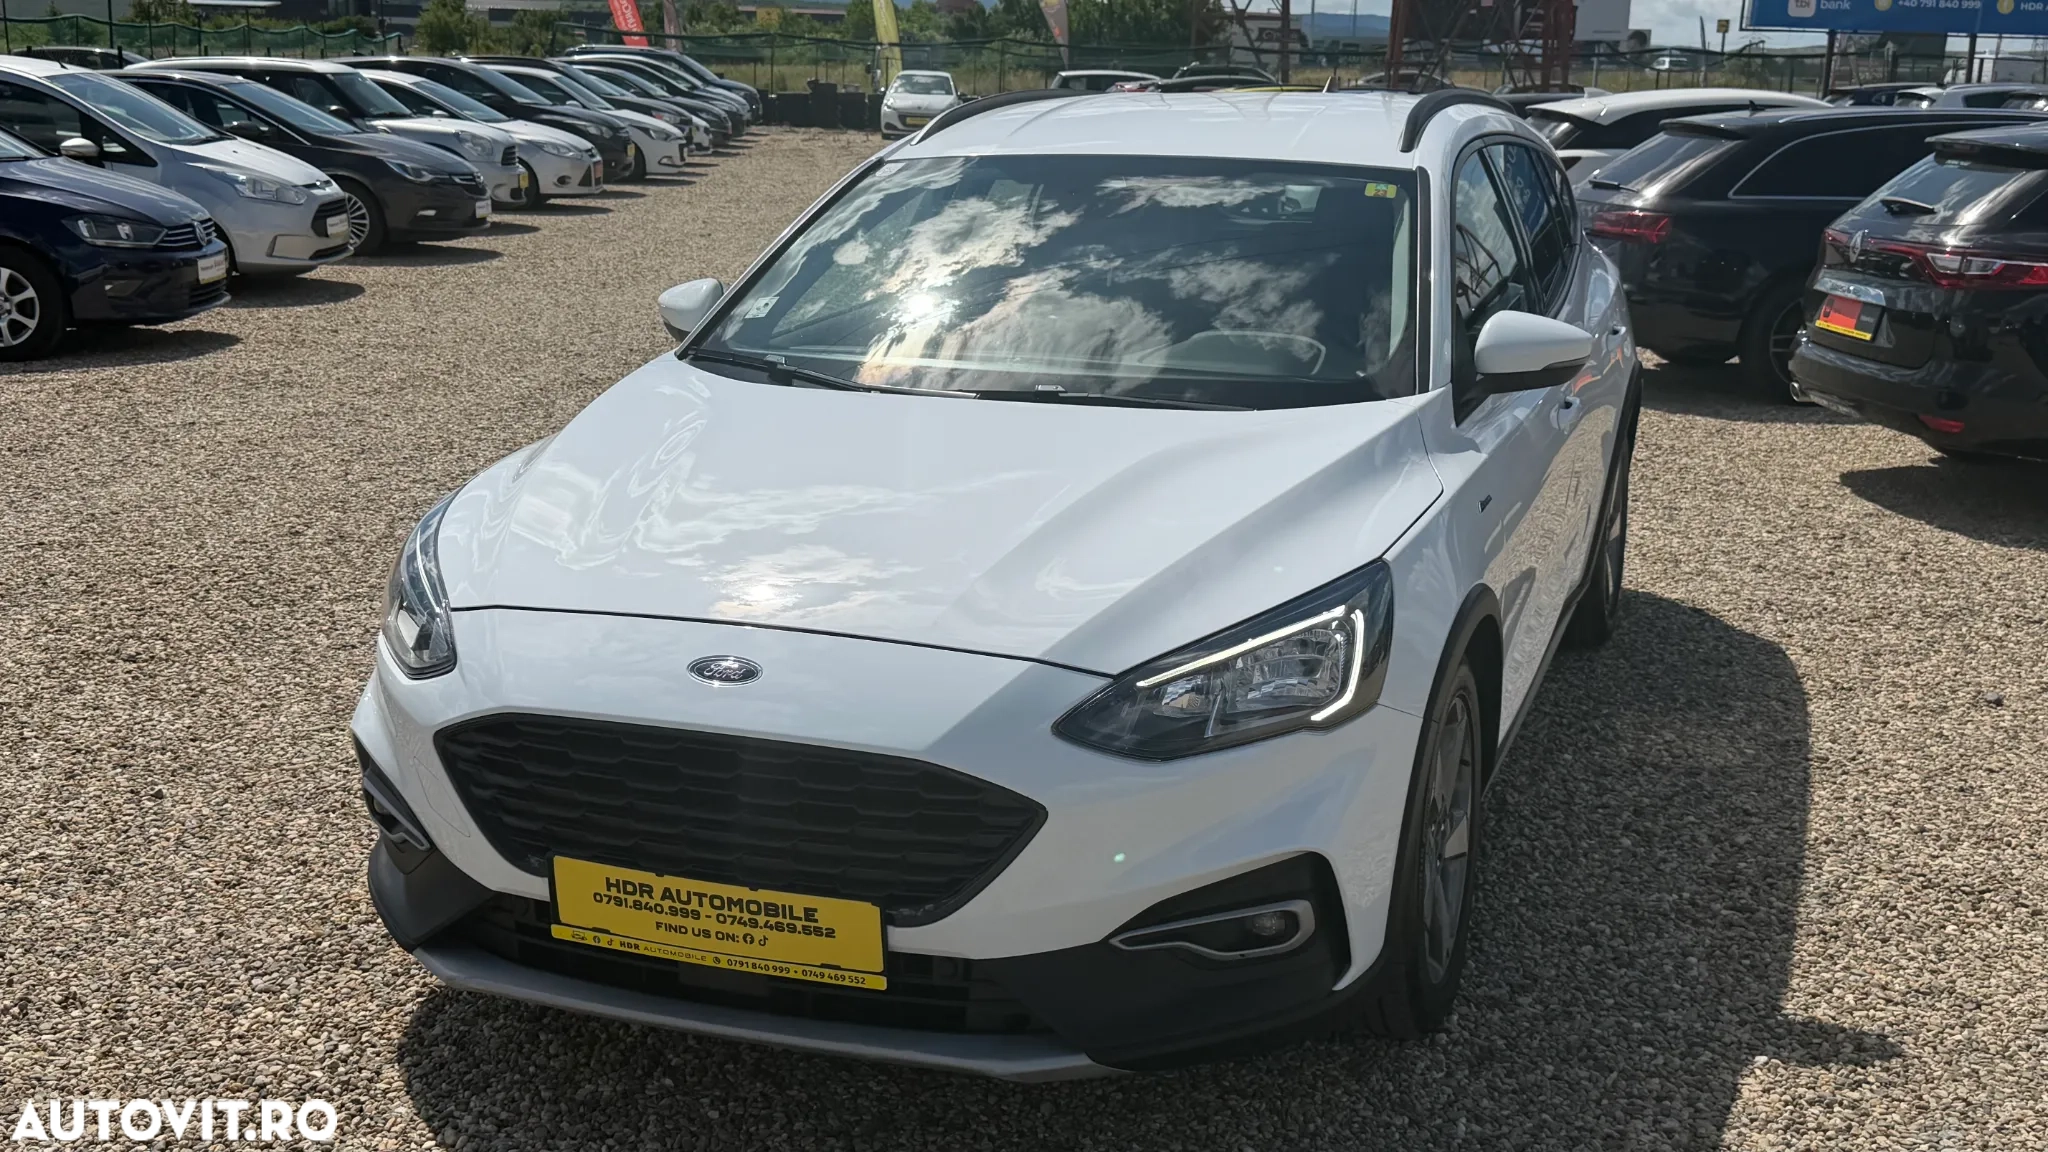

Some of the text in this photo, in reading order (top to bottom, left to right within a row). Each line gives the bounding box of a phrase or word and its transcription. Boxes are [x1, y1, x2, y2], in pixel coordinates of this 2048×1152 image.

[1820, 0, 1851, 10] bank
[1920, 0, 1937, 8] 791
[1938, 0, 1959, 8] 840
[1961, 0, 1981, 9] 999
[2020, 2, 2043, 11] HDR
[704, 663, 746, 679] Ford
[605, 877, 819, 923] HDR AUTOMOBILE
[593, 892, 701, 920] 0791.840.999
[716, 913, 836, 938] 0749.469.552
[655, 921, 739, 943] FIND US ON:
[620, 940, 866, 984] HDR AUTOMOBILE 0791 840 999 0749 469 552
